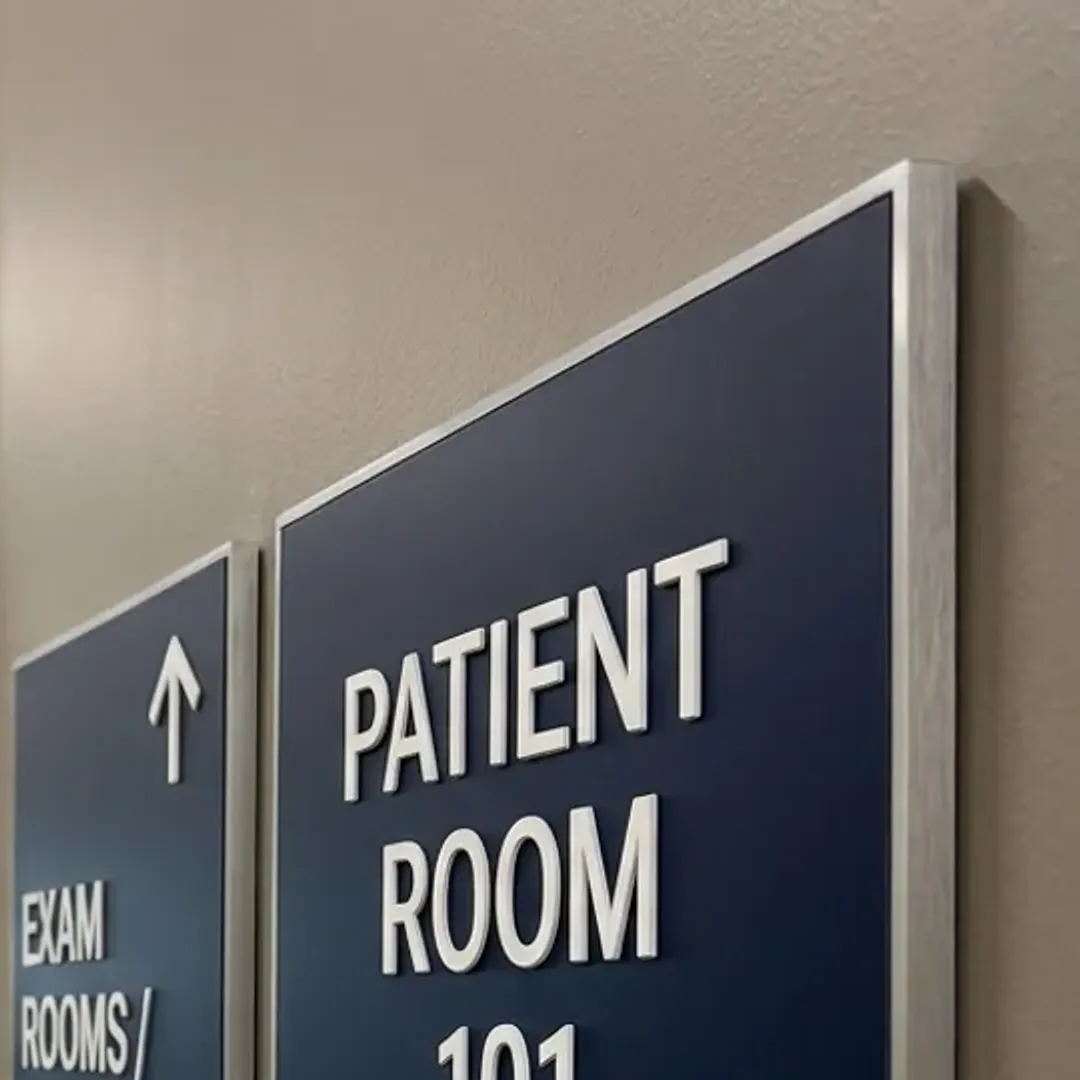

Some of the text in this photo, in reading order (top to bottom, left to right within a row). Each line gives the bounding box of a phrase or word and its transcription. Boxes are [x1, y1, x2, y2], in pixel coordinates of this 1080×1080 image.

[344, 538, 729, 802] PATIENT
[22, 880, 104, 968] EXAM
[382, 793, 659, 976] ROOM
[22, 991, 128, 1075] ROOMS
